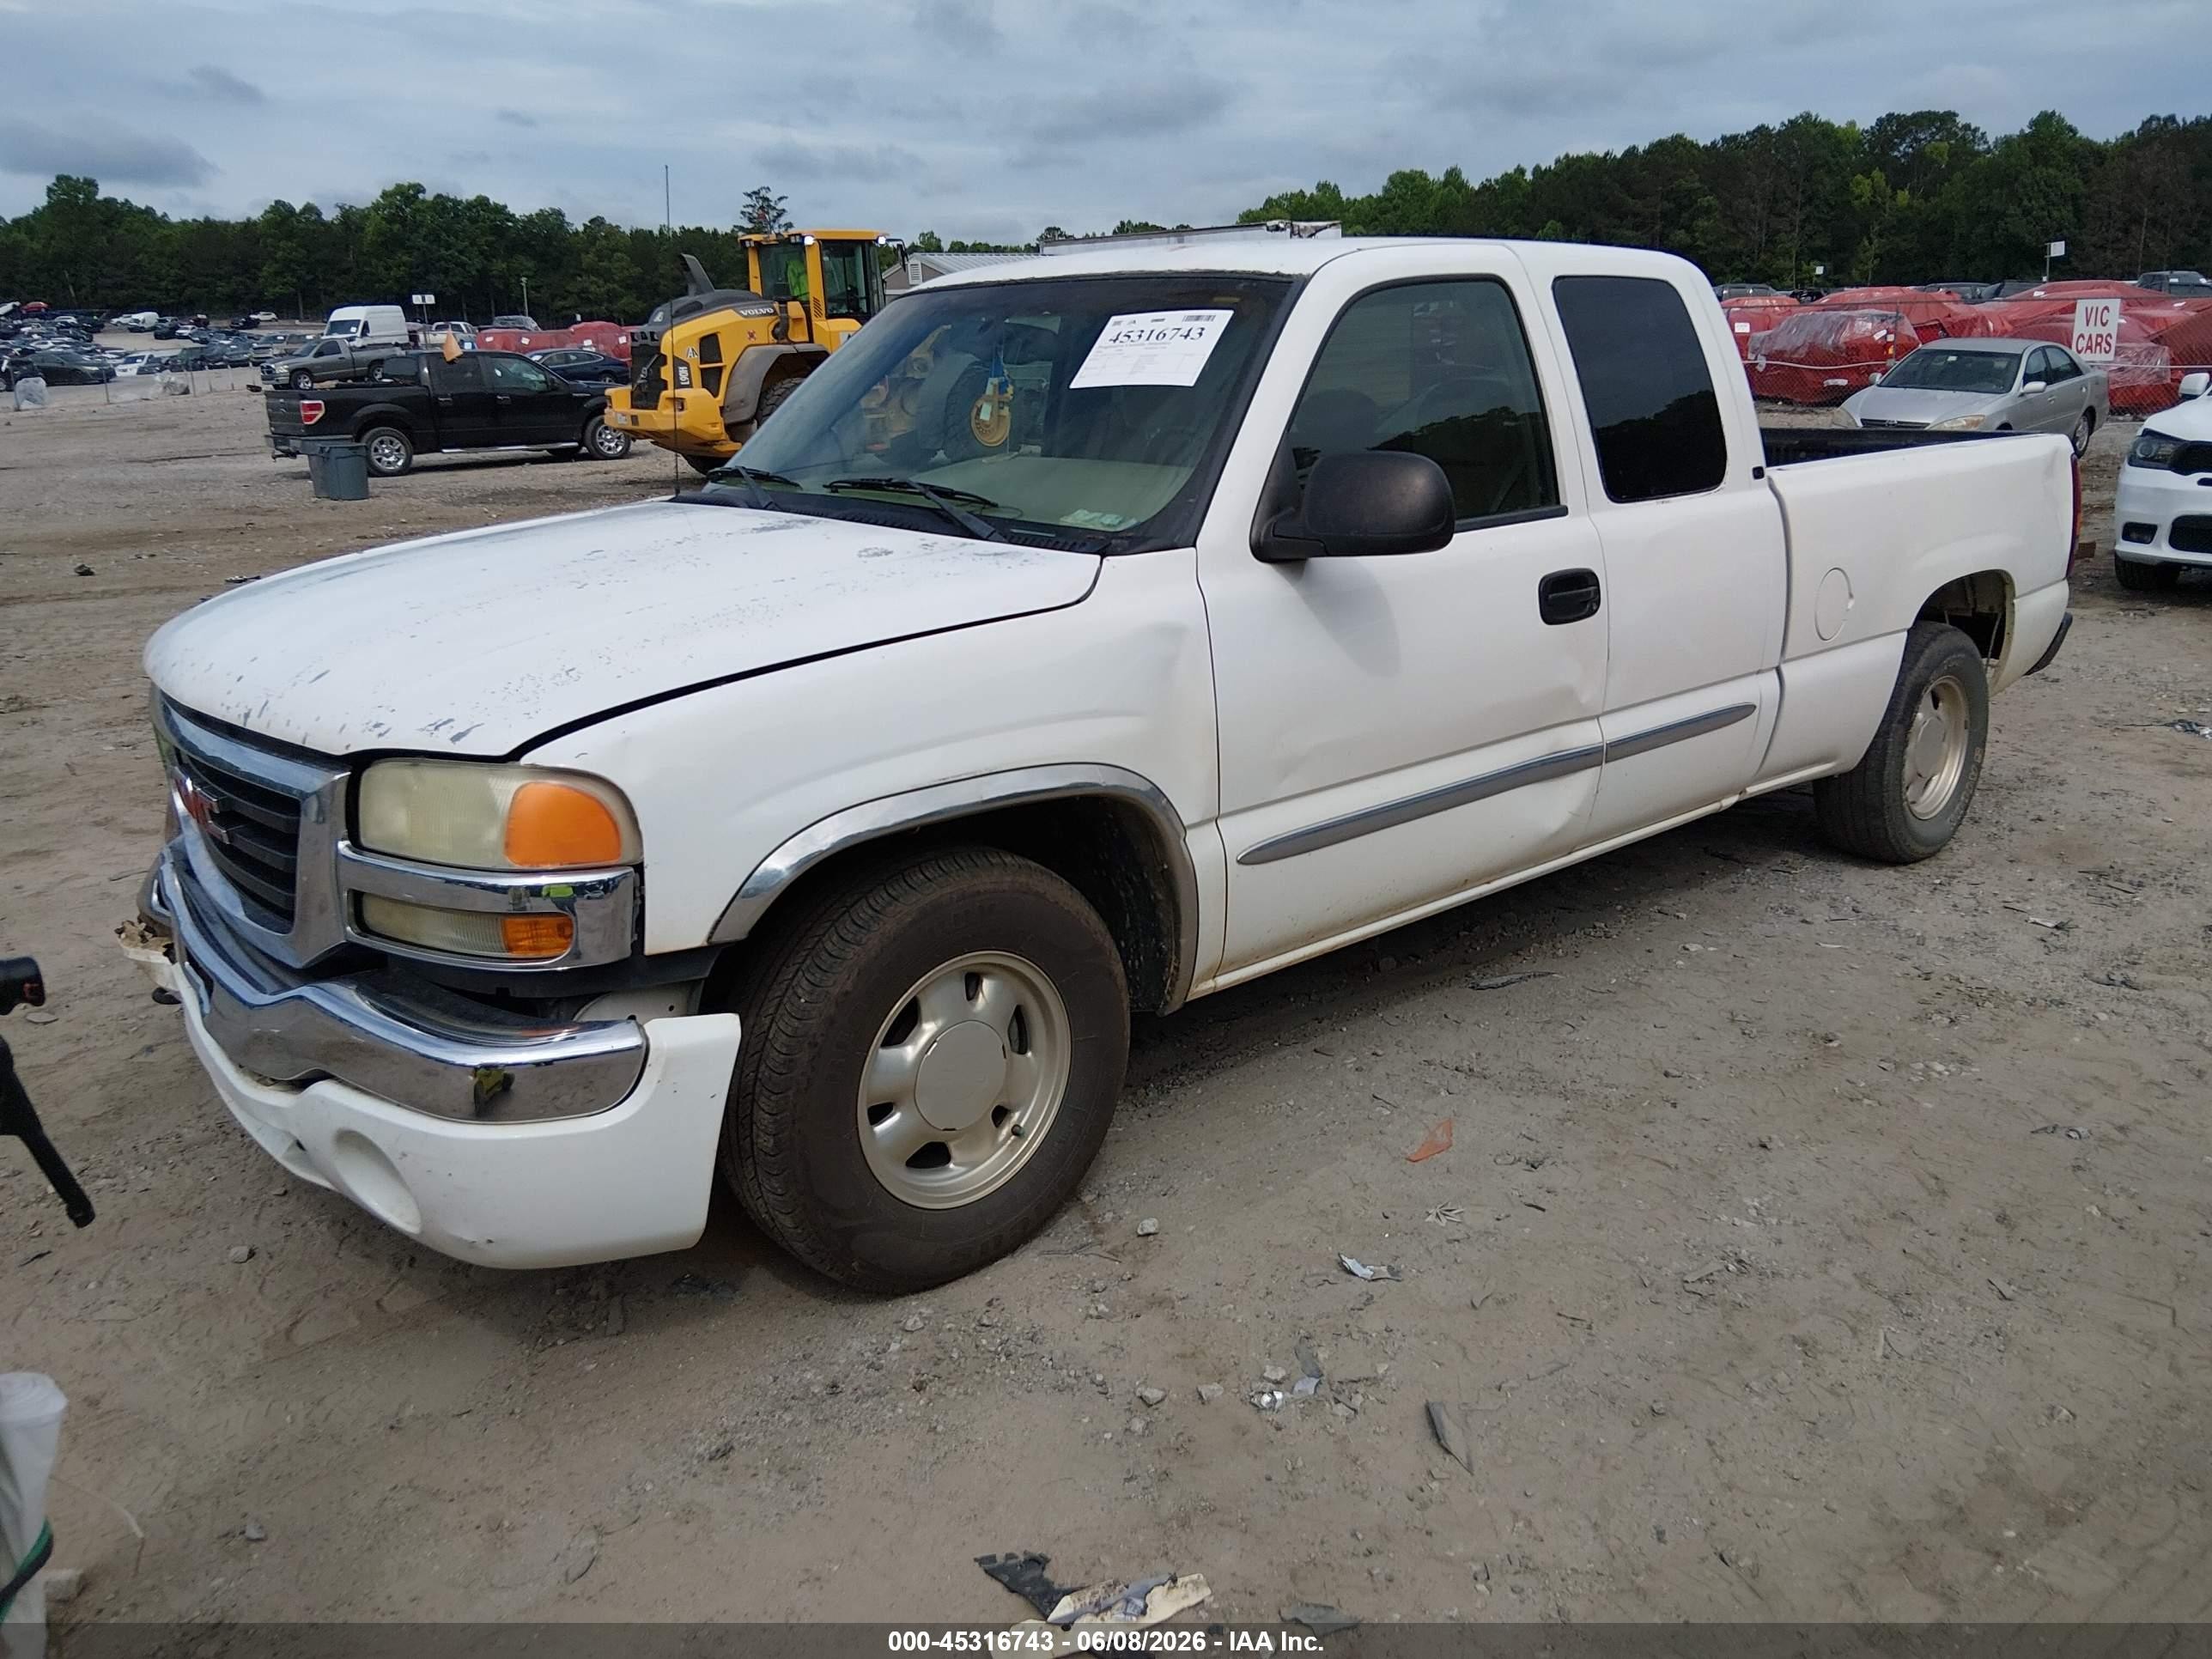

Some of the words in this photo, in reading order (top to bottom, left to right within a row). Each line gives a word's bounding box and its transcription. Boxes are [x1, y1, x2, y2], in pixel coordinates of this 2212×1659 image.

[739, 307, 775, 316] VOLVO
[2085, 306, 2110, 327] VIC
[1109, 327, 1206, 343] 45316743
[2075, 332, 2112, 354] CARS
